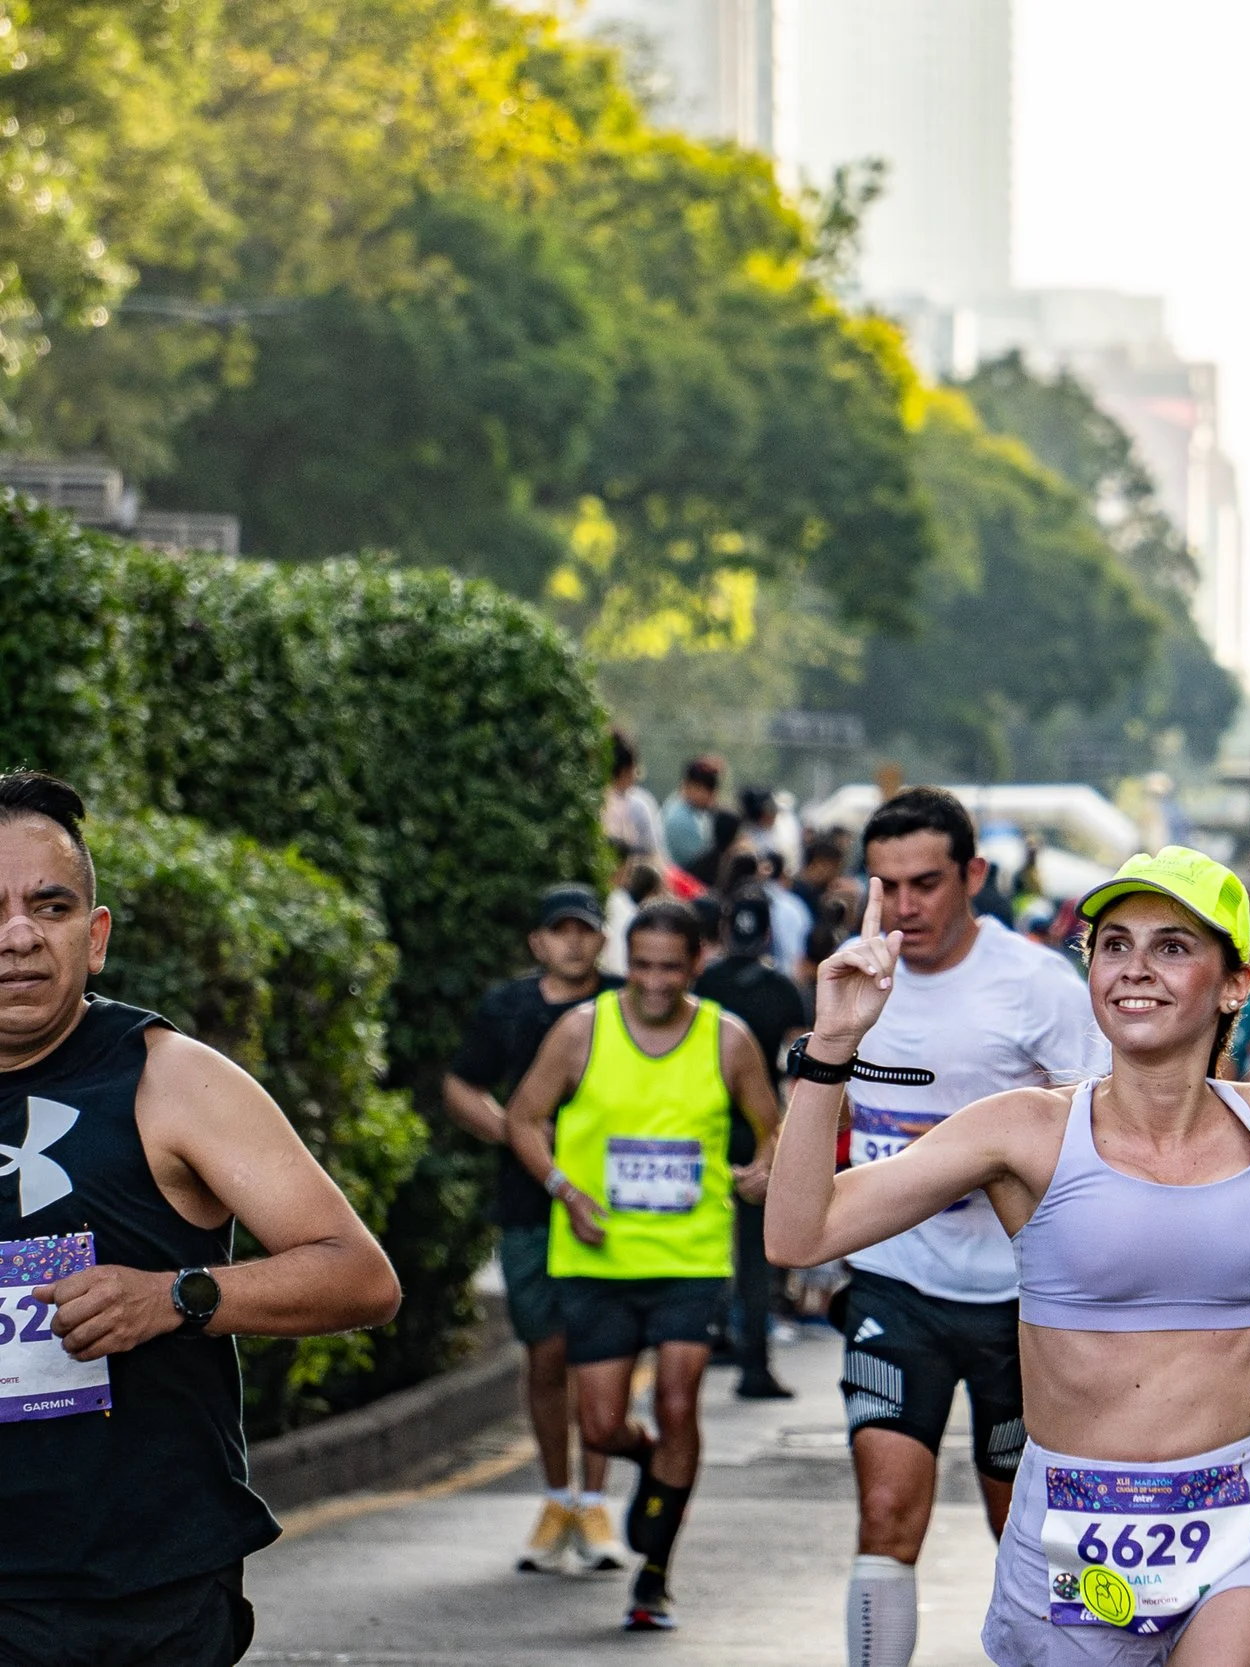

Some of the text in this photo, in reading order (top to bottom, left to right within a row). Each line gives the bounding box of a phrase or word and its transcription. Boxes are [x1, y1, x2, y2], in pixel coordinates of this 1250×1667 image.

[23, 1397, 76, 1413] GARMIN
[1078, 1520, 1211, 1568] 6629
[1126, 1573, 1162, 1586] LAILA
